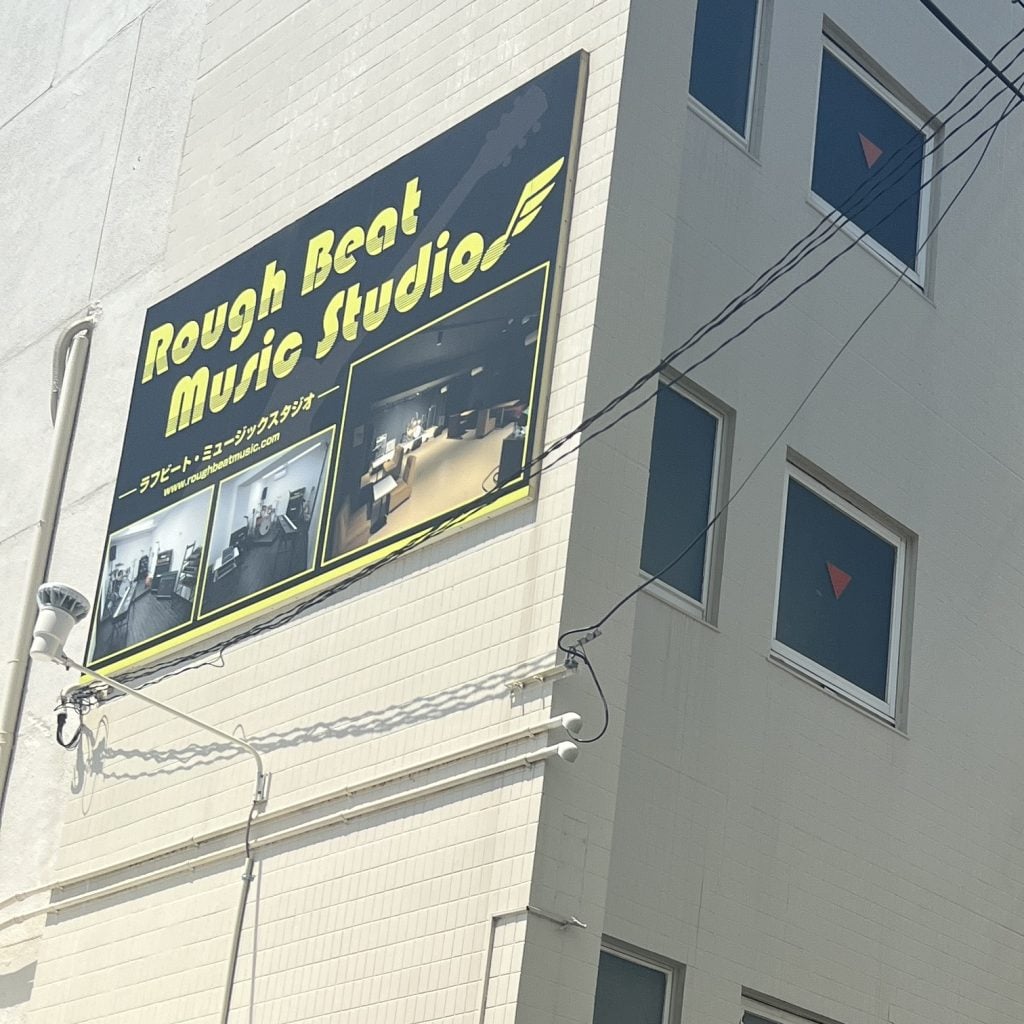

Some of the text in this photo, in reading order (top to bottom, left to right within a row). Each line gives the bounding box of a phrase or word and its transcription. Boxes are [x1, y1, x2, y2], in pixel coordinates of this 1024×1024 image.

[142, 177, 421, 384] Rough Beat
[165, 229, 487, 437] Music Studio
[139, 392, 315, 493] ラフビート・ミュージックスタジオ
[163, 432, 281, 496] www.roughbeatmusic.com
